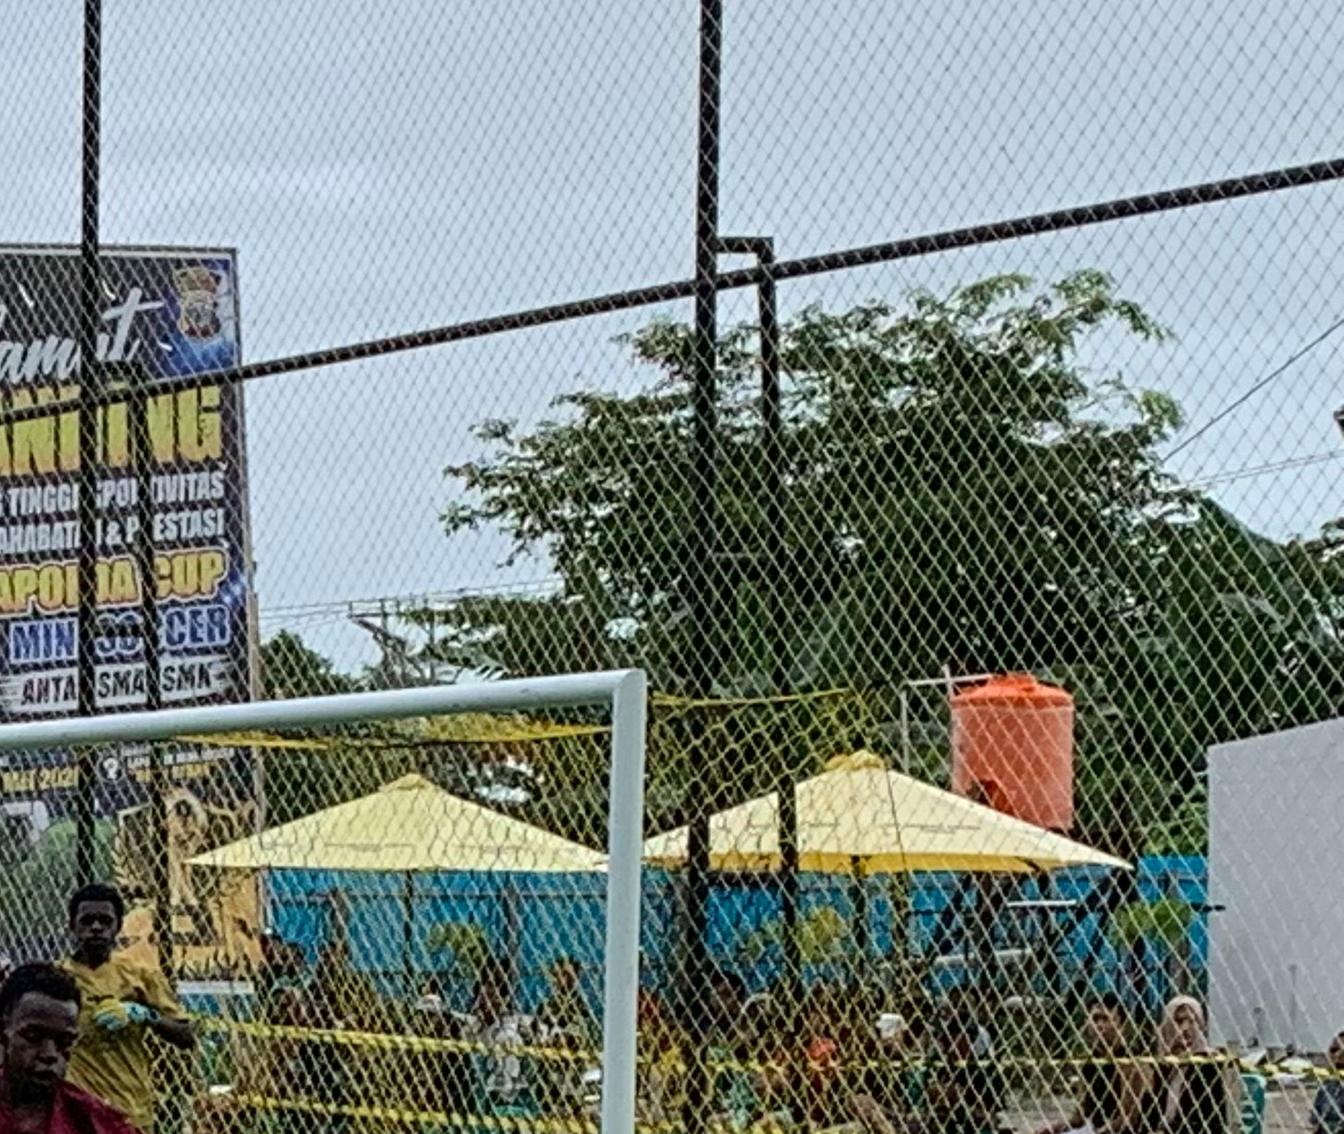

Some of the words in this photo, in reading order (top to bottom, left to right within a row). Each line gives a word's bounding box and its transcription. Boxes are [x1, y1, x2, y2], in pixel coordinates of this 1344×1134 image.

[106, 519, 122, 546] &
[126, 507, 225, 545] PESTASI
[10, 618, 79, 662] MIN
[95, 606, 229, 656] SOCER
[22, 676, 79, 705] ANTA
